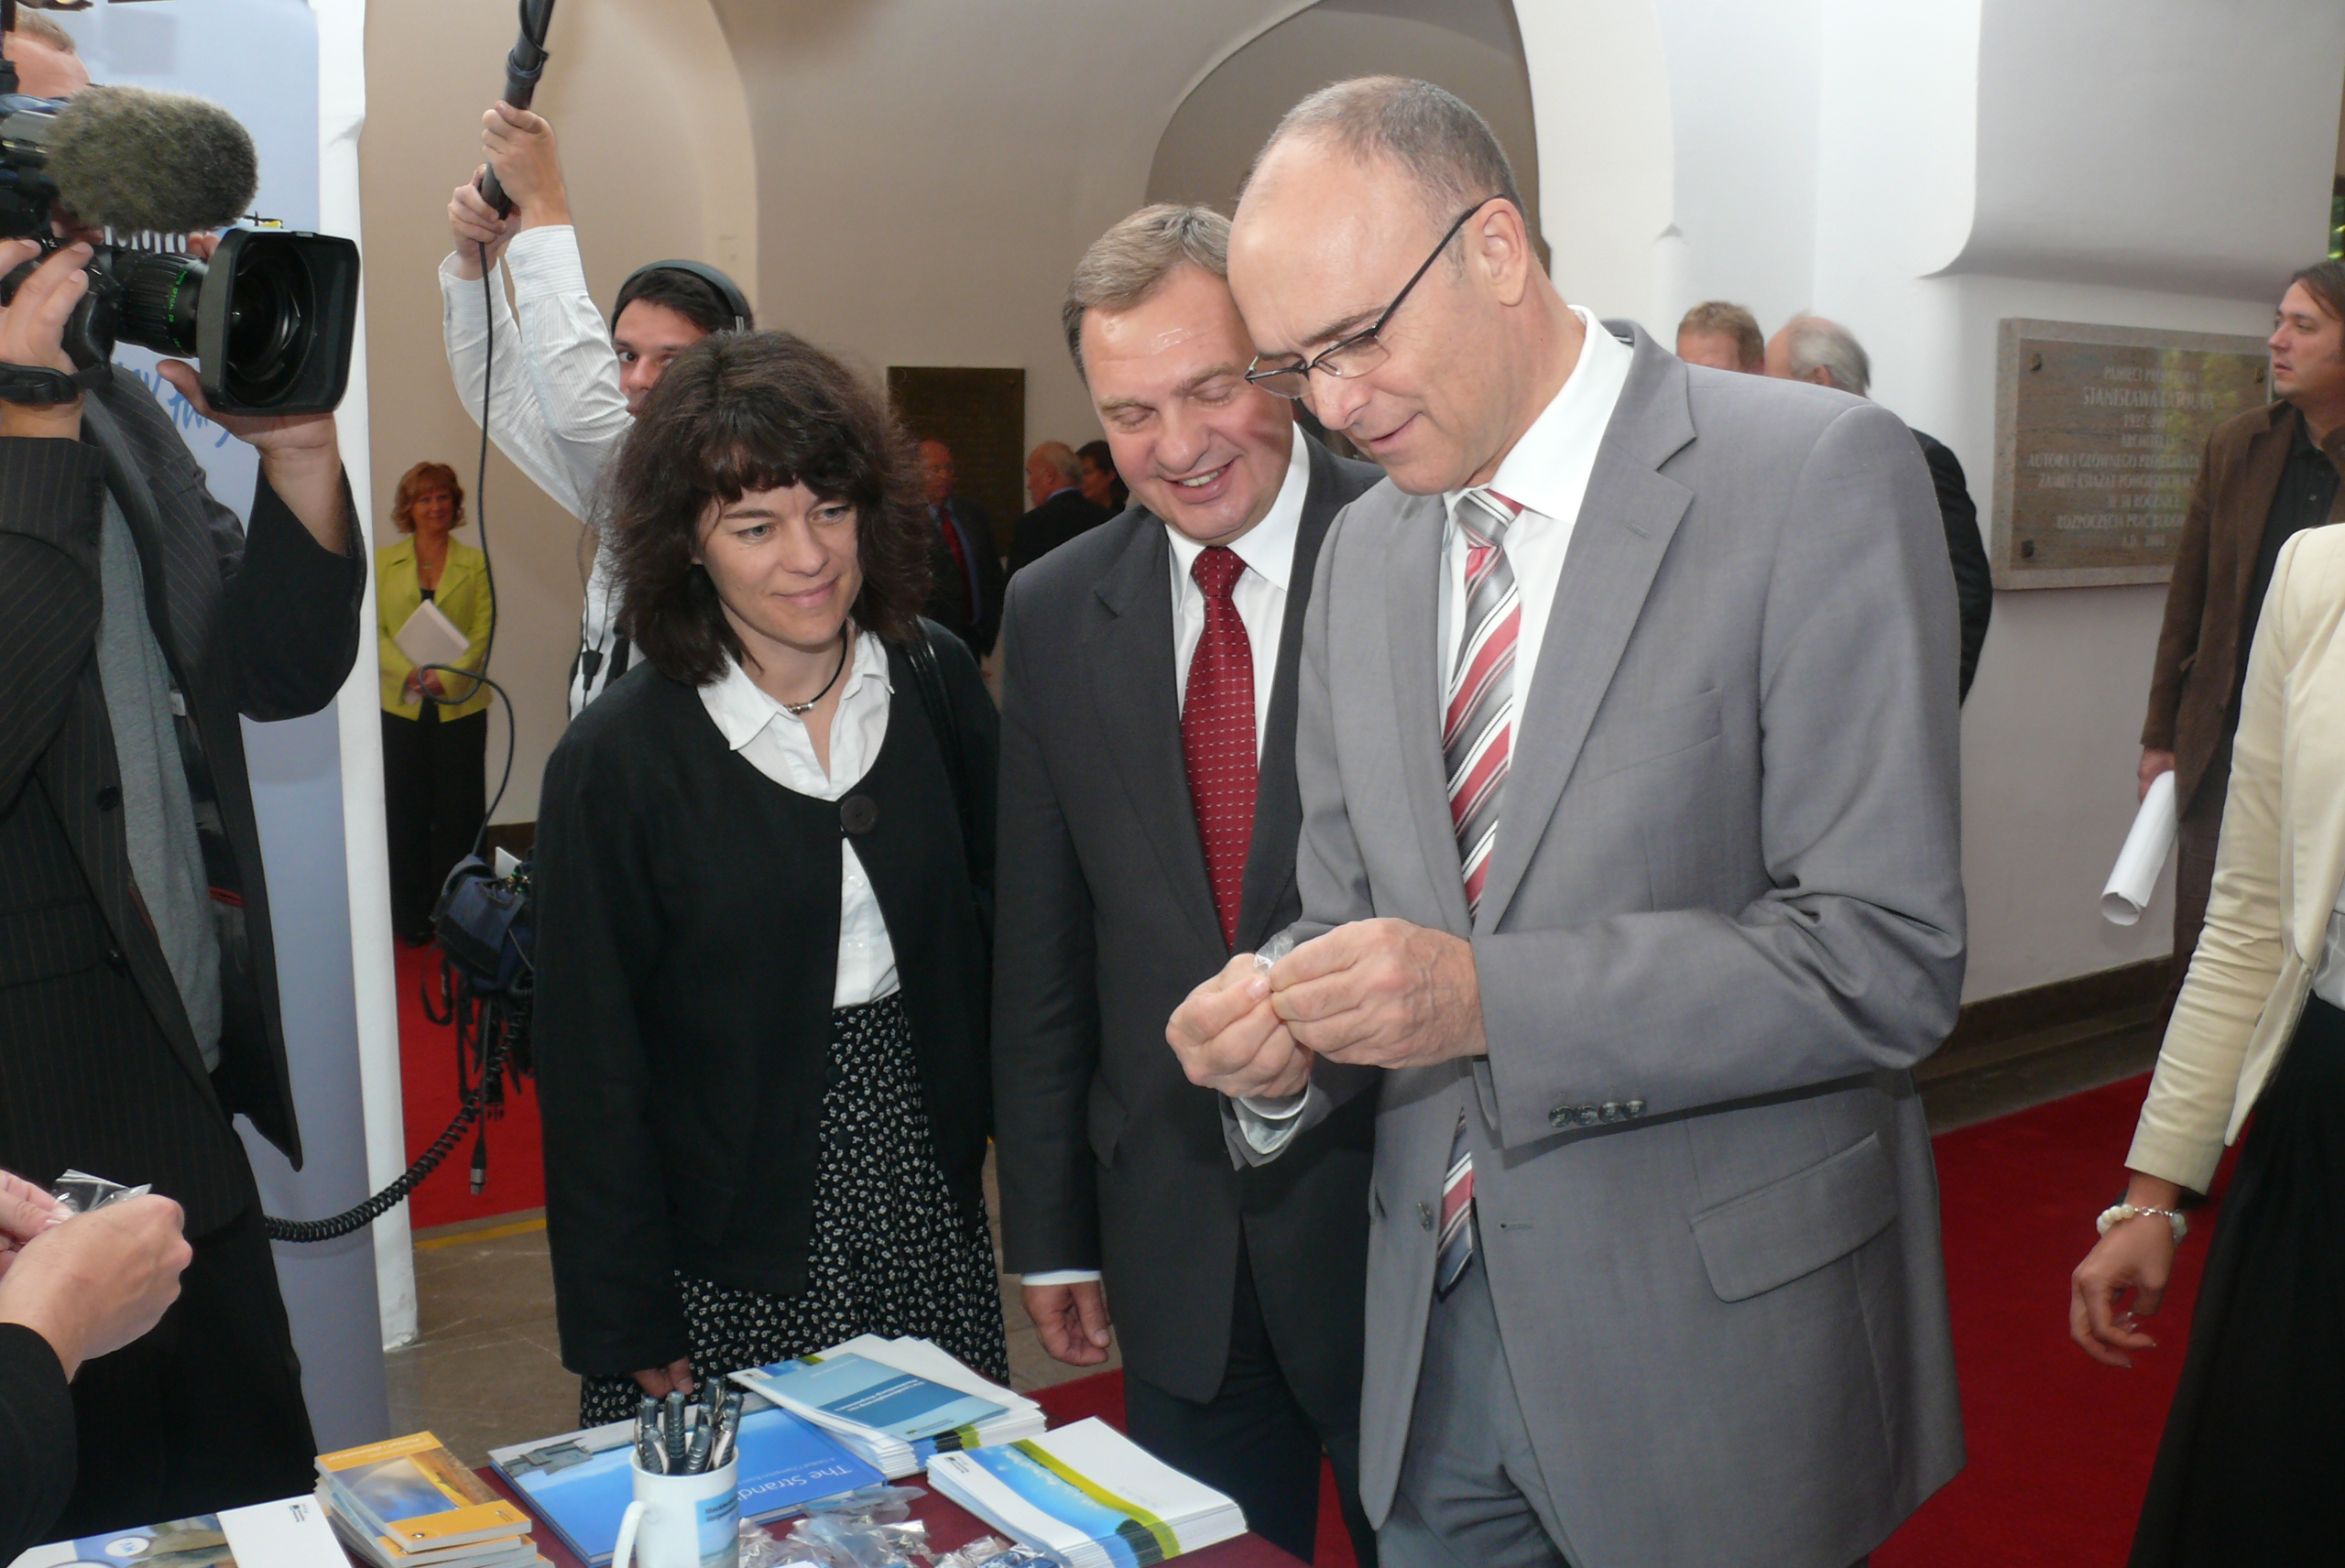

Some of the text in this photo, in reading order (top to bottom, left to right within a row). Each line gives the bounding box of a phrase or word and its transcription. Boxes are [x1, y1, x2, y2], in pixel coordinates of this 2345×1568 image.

[2081, 386, 2157, 408] STANISŁAWA
[737, 1465, 853, 1501] The Strand
